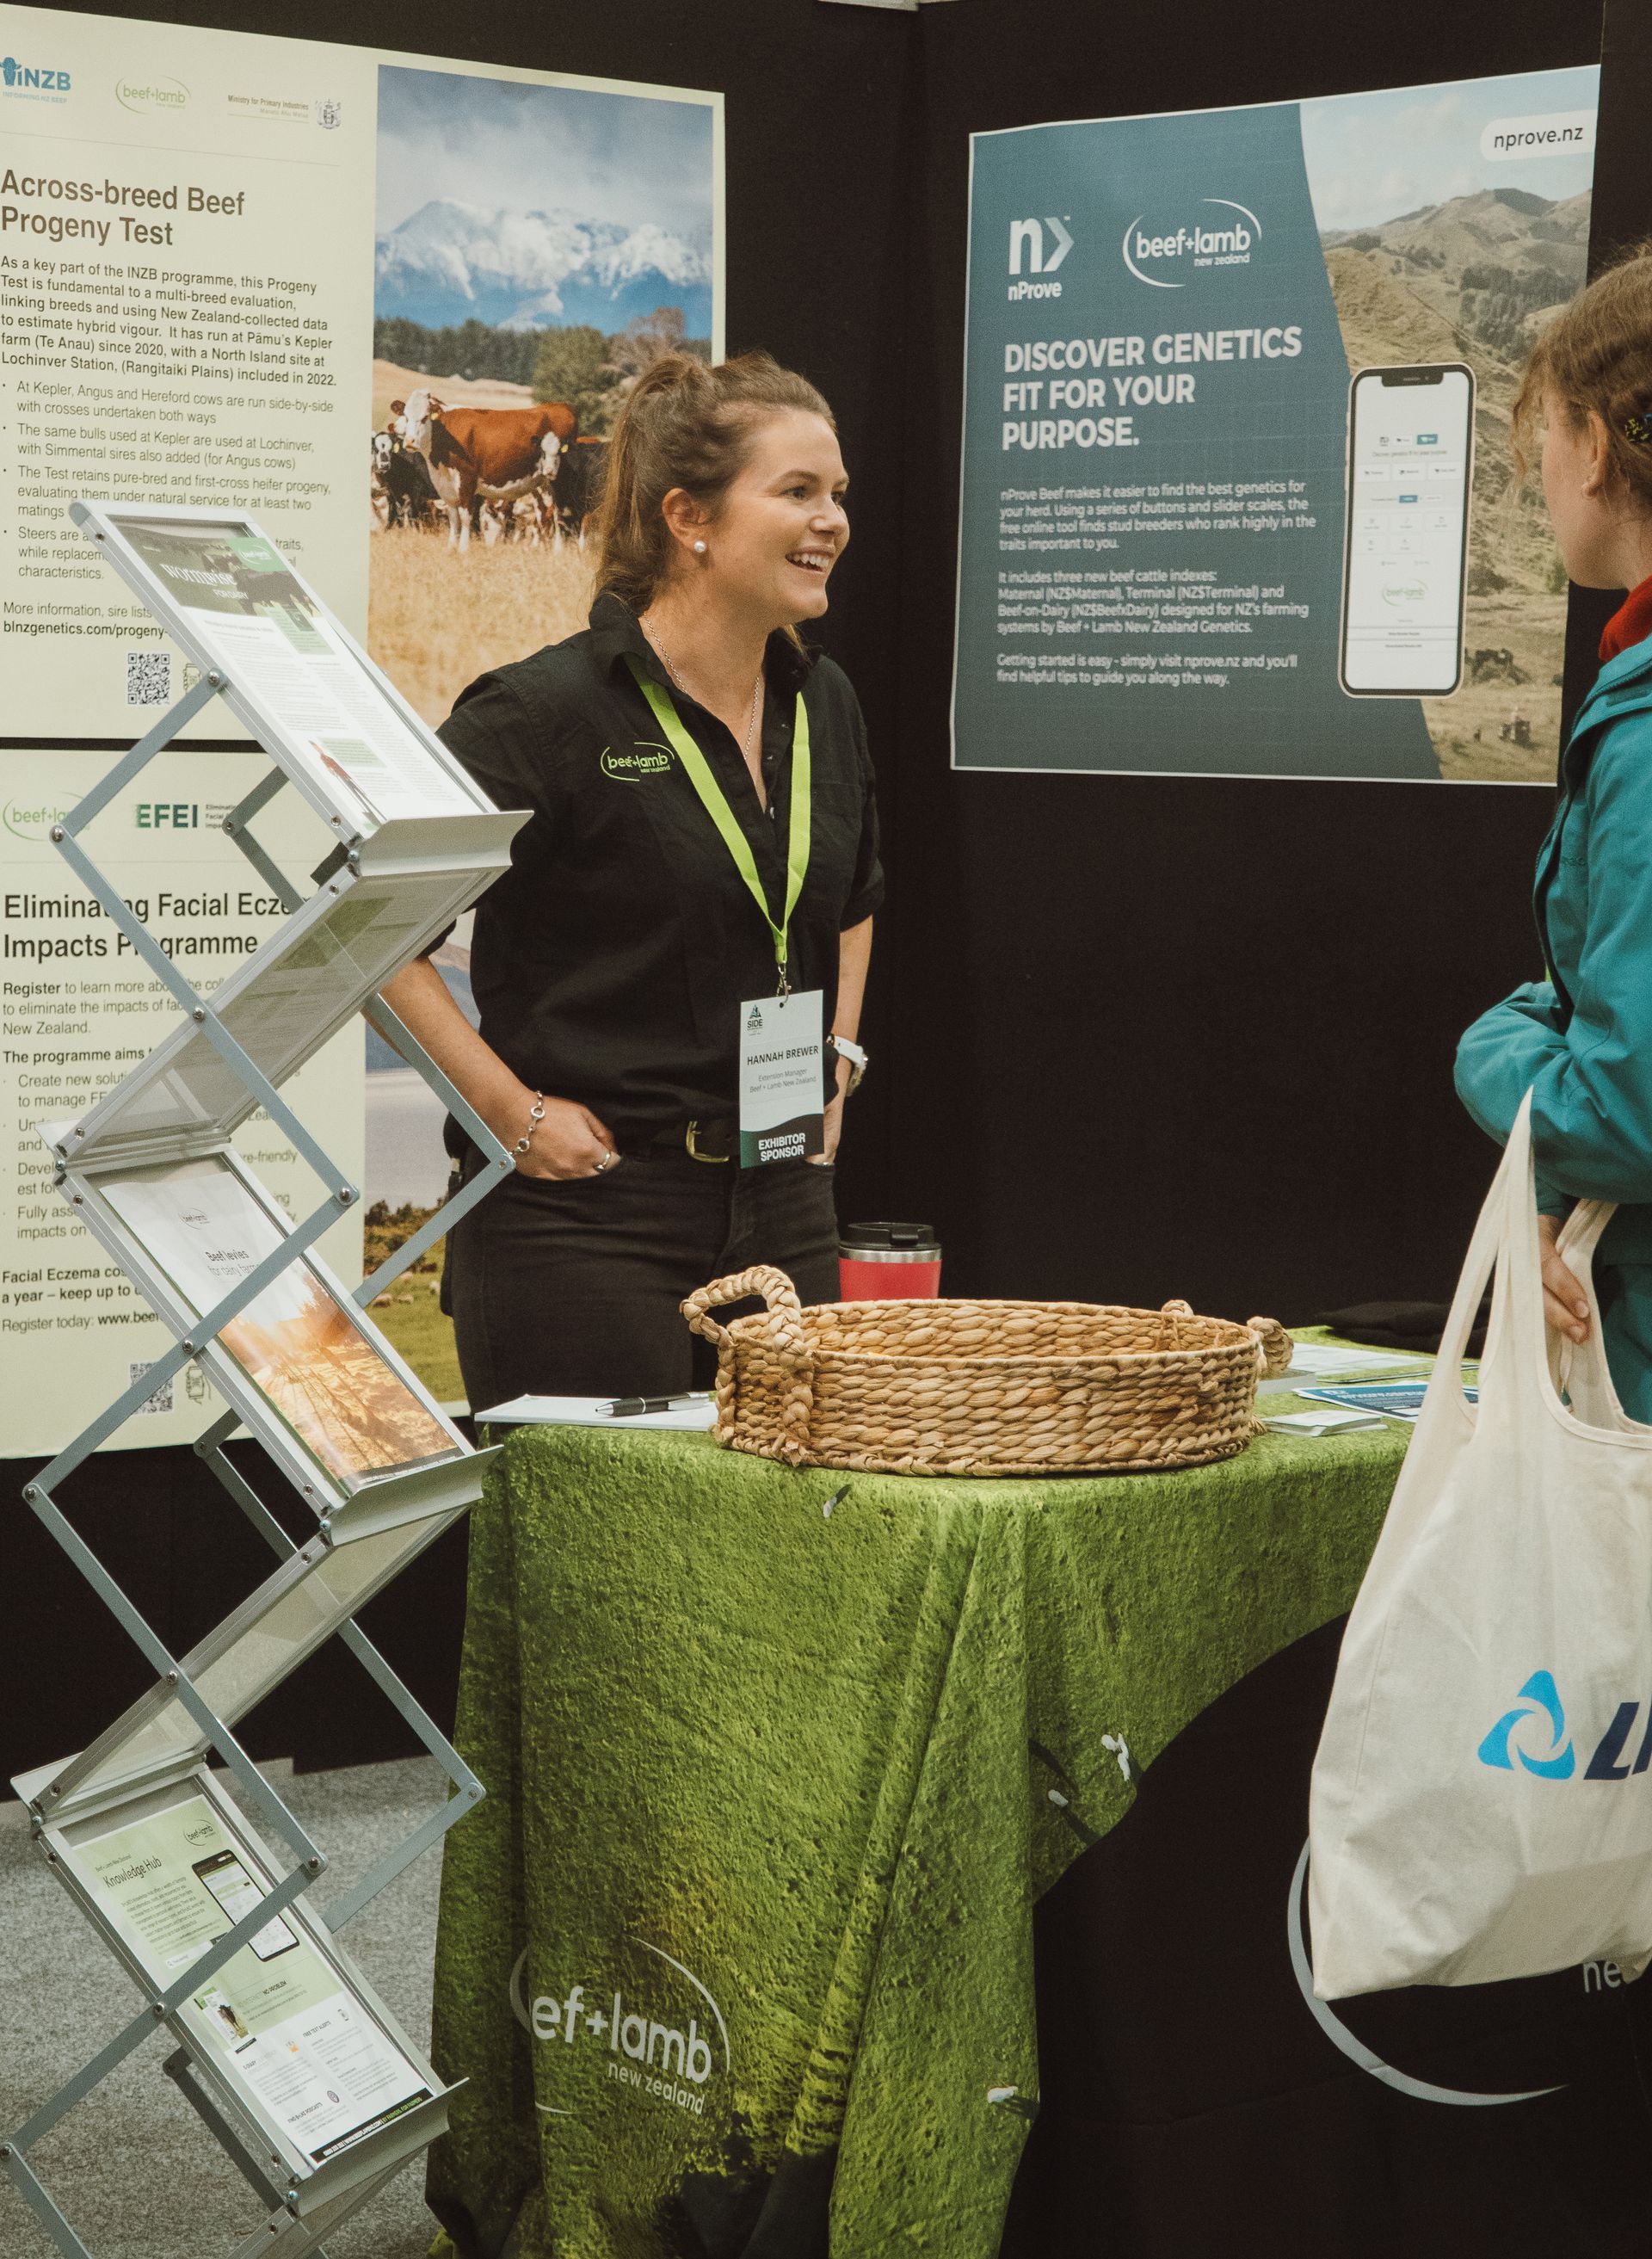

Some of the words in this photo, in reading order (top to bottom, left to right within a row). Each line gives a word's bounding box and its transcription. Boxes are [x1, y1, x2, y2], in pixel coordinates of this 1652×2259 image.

[227, 95, 250, 106] Ministry
[260, 98, 281, 109] Primary
[282, 101, 309, 111] Industries
[1494, 127, 1584, 151] nprove.nz
[0, 169, 177, 210] Across-breed
[188, 186, 244, 215] Beef
[2, 205, 111, 246] Progeny
[119, 216, 173, 245] Test
[1136, 223, 1251, 259] beef+lamb
[1193, 256, 1214, 268] new
[1214, 253, 1250, 266] zealand
[1, 255, 18, 268] As
[22, 259, 29, 269] a
[34, 257, 56, 275] key
[60, 262, 84, 275] part
[88, 262, 100, 275] of
[104, 264, 123, 278] the
[127, 266, 157, 281] INZB
[162, 271, 237, 287] programme,
[241, 275, 263, 289] this
[268, 277, 317, 296] Progeny
[1, 274, 28, 288] Test
[32, 280, 43, 290] is
[46, 278, 124, 296] fundamental
[128, 286, 140, 298] to
[144, 289, 151, 299] a
[156, 288, 226, 305] multi-breed
[230, 294, 296, 310] evaluation,
[1008, 281, 1063, 301] nProve
[1, 293, 45, 312] linking
[49, 297, 92, 312] breeds
[96, 303, 118, 315] and
[122, 305, 157, 321] using
[161, 306, 188, 319] New
[191, 308, 299, 328] Zealand-collected
[303, 318, 328, 330] data
[1, 313, 14, 326] to
[17, 316, 72, 330] estimate
[77, 318, 115, 335] hybrid
[120, 323, 162, 338] vigour.
[170, 325, 177, 338] It
[181, 327, 203, 340] has
[207, 331, 228, 342] run
[231, 331, 243, 343] at
[295, 335, 333, 350] Kepler
[1, 331, 30, 346] farm
[34, 334, 54, 349] (Te
[58, 336, 95, 354] Anau)
[98, 342, 131, 354] since
[135, 342, 166, 356] 2020,
[170, 346, 196, 358] with
[200, 349, 207, 359] a
[212, 347, 245, 361] North
[250, 350, 286, 364] Island
[289, 354, 311, 366] site
[313, 355, 324, 367] at
[1004, 336, 1145, 373] DISCOVER
[1152, 325, 1302, 364] GENETICS
[2, 351, 66, 367] Lochinver
[71, 355, 117, 372] Station,
[121, 360, 187, 377] (Rangitaiki
[191, 364, 233, 381] Plains)
[237, 367, 289, 383] included
[293, 371, 303, 383] in
[307, 372, 336, 386] 2022.
[16, 380, 29, 393] At
[34, 380, 74, 398] Kepler,
[77, 384, 114, 401] Angus
[116, 388, 138, 400] and
[141, 388, 190, 404] Hereford
[193, 394, 223, 405] cows
[226, 396, 244, 407] are
[248, 398, 266, 408] run
[268, 398, 334, 413] side-by-side
[1003, 381, 1044, 411] FIT
[1049, 378, 1106, 410] FOR
[1113, 373, 1195, 406] YOUR
[1002, 416, 1139, 450] PURPOSE.
[1039, 486, 1064, 500] Beef
[1064, 485, 1101, 499] makes
[1147, 485, 1160, 497] to
[1161, 483, 1184, 496] find
[1185, 482, 1205, 496] the
[1207, 482, 1233, 495] best
[1234, 481, 1286, 497] genetics
[1288, 478, 1306, 493] for
[18, 504, 65, 521] matings
[18, 565, 103, 579] characteristics.
[136, 804, 198, 828] EFEI
[4, 893, 149, 923] Eliminang
[158, 892, 228, 917] Facial
[4, 934, 108, 964] Impacts
[117, 932, 257, 963] Pgramme
[3, 982, 61, 998] Register
[65, 982, 77, 994] to
[80, 982, 110, 993] learn
[114, 983, 145, 992] more
[3, 1003, 15, 1015] to
[18, 1002, 77, 1015] eliminate
[80, 1000, 99, 1013] the
[103, 1000, 149, 1015] impacts
[151, 998, 163, 1012] of
[3, 1021, 32, 1035] New
[36, 1021, 90, 1034] Zealand.
[747, 1019, 763, 1028] SIDE
[3, 1050, 28, 1063] The
[33, 1051, 111, 1065] programme
[114, 1047, 145, 1059] aims
[747, 1051, 784, 1065] HANNAH
[786, 1045, 819, 1059] BREWER
[758, 1072, 784, 1082] Extension
[785, 1069, 808, 1077] Manager
[758, 1133, 806, 1151] EXHIBITOR
[760, 1145, 804, 1162] SPONSOR
[2, 1268, 42, 1283] Facial
[46, 1268, 100, 1281] Eczema
[2, 1293, 9, 1304] a
[14, 1291, 43, 1306] year
[59, 1287, 92, 1301] keep
[96, 1287, 114, 1300] up
[117, 1285, 131, 1296] to
[102, 1864, 146, 1889] Knowledge
[144, 1855, 162, 1871] Hub
[1582, 1960, 1622, 1993] ne
[532, 1984, 712, 2083] ef+lamb
[607, 2062, 643, 2088] new
[644, 2075, 706, 2115] zealand
